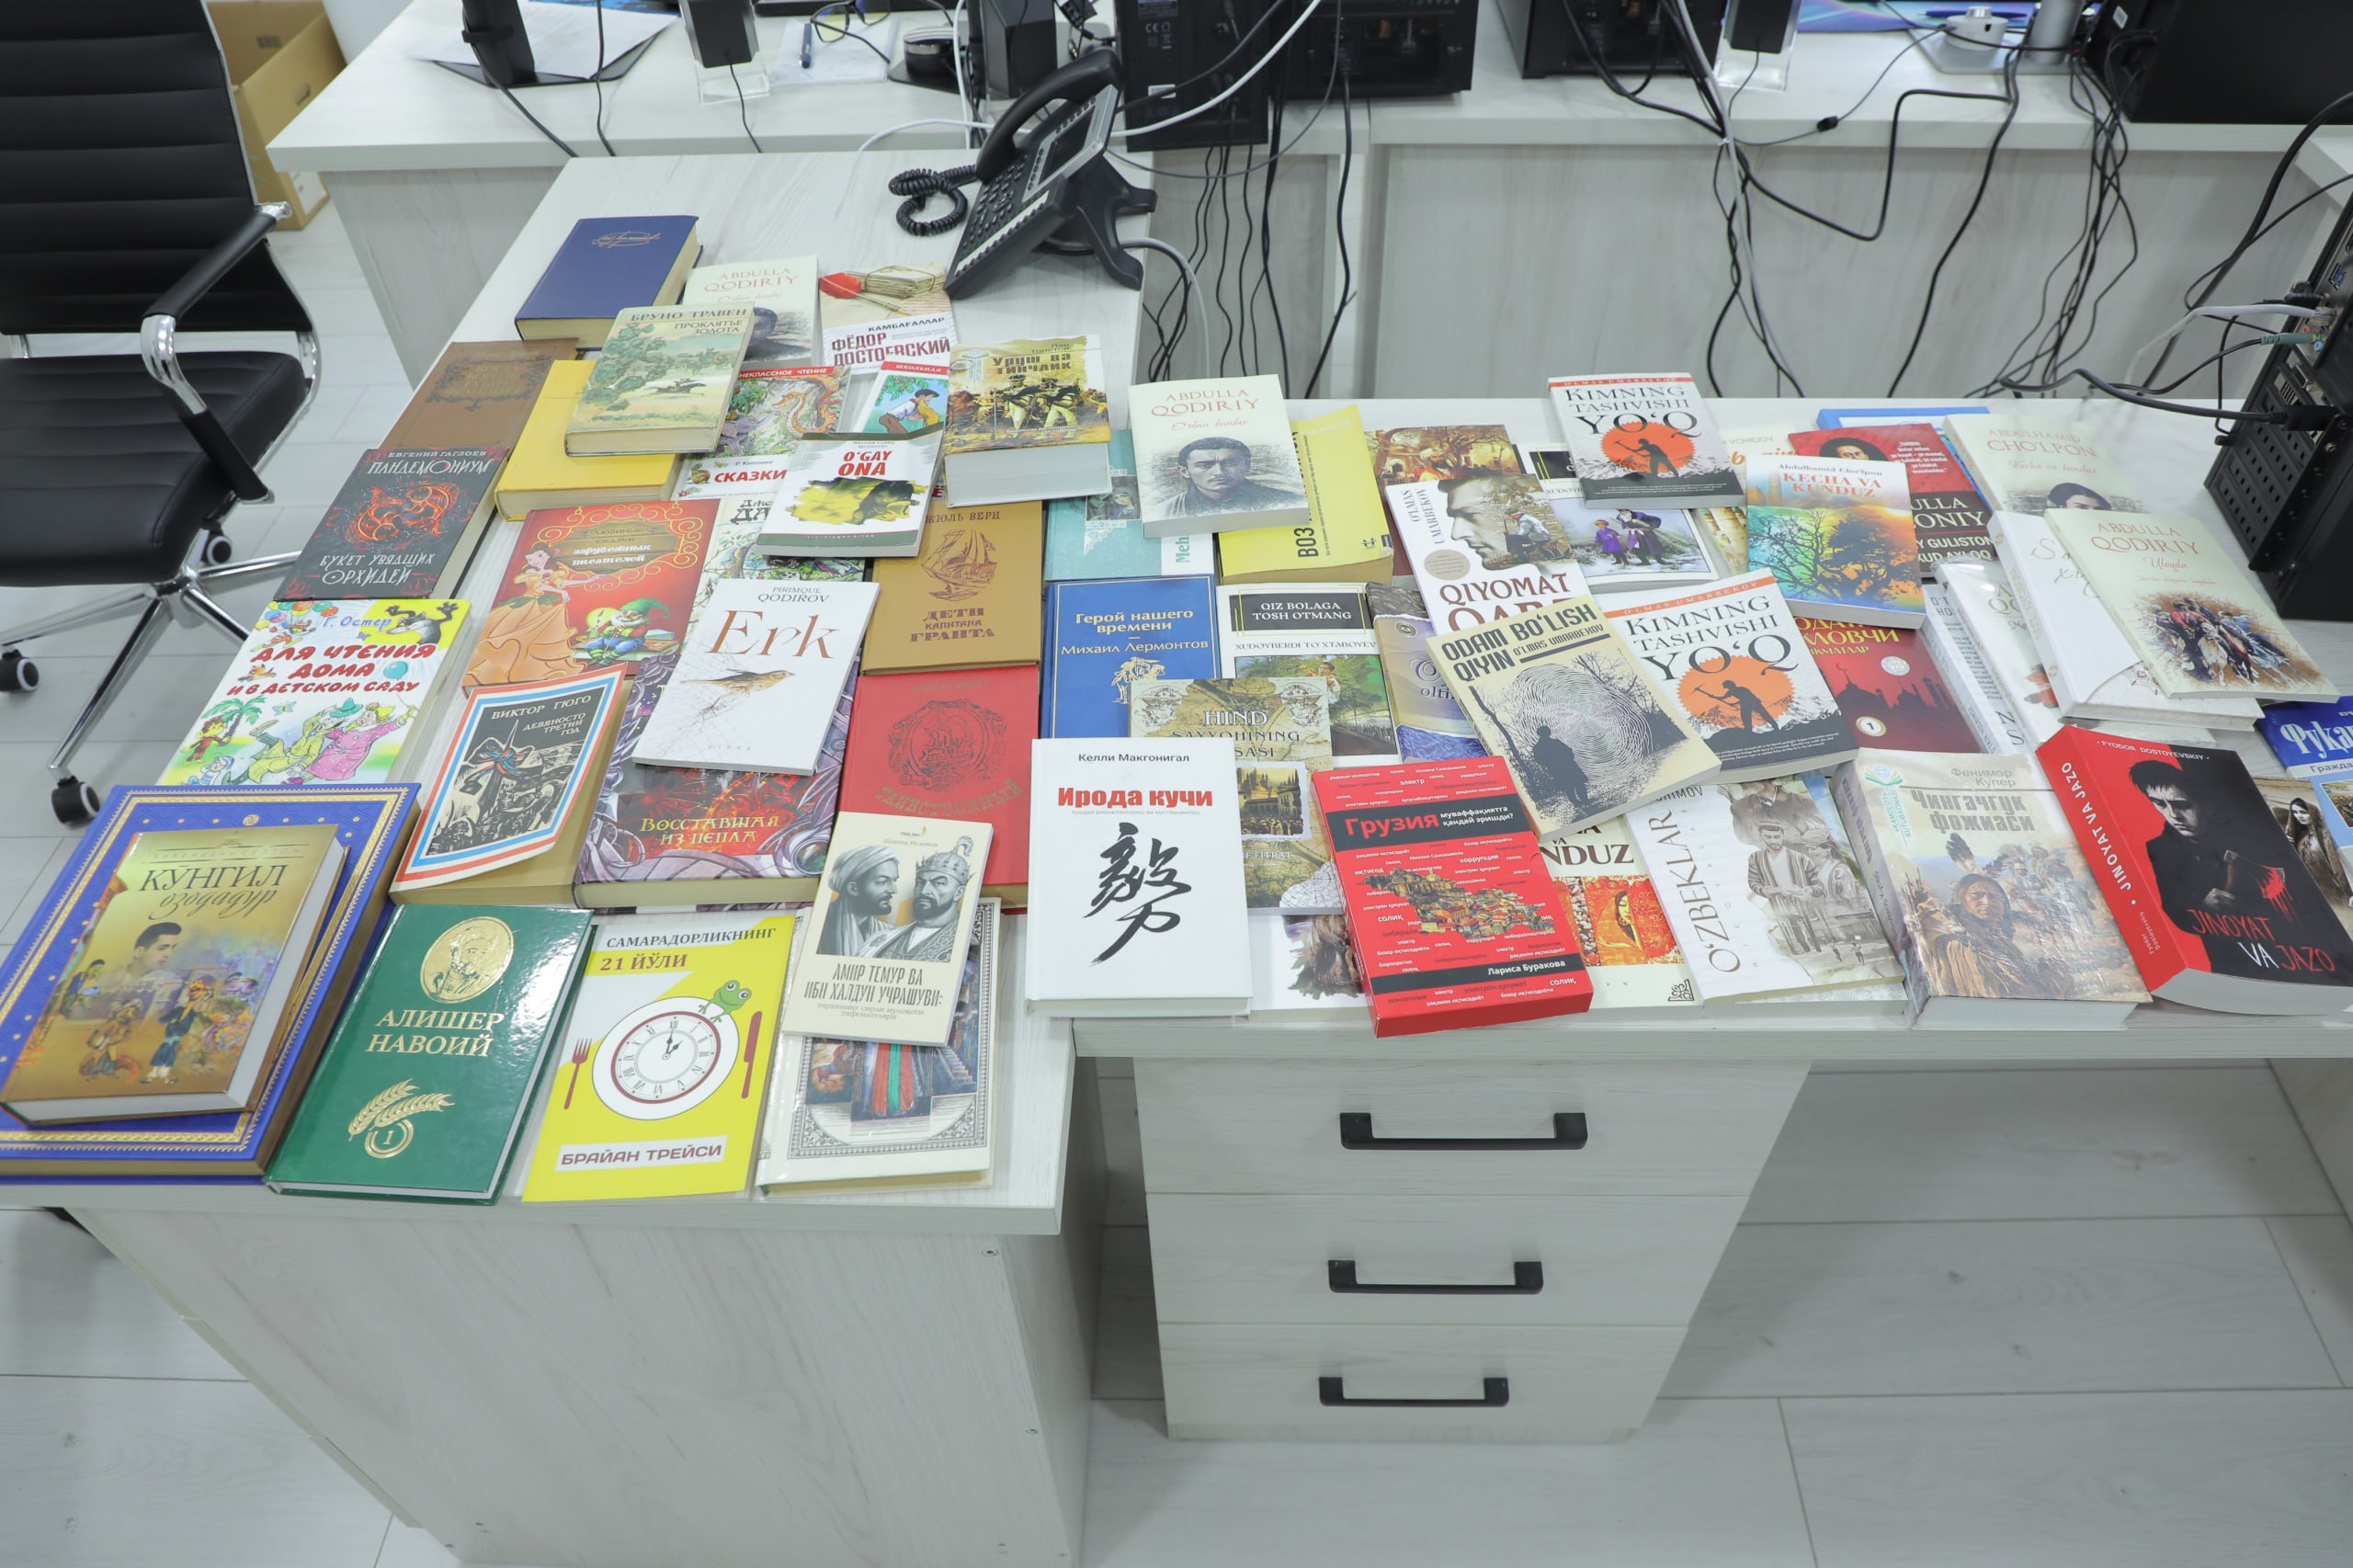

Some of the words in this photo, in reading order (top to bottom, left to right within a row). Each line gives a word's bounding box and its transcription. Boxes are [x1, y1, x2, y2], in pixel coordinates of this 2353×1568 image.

[719, 268, 790, 280] ABDULLA
[705, 276, 798, 291] QODIRIY
[631, 312, 683, 322] БРУНО
[690, 309, 747, 317] ТРАВЕН
[675, 320, 743, 330] ПРОКЛЯТЬЕ
[832, 333, 887, 352] ФЁДОР
[834, 337, 951, 367] ДОСТОЕВСКИЙ
[738, 369, 792, 379] НЕКЛАССНОЕ
[797, 368, 827, 376] ЧТЕНИЕ
[1165, 389, 1249, 402] ABDULLA
[1565, 386, 1685, 401] KIMNING
[1152, 398, 1259, 416] QODIRIY
[1569, 399, 1690, 413] TASHVISHI
[368, 459, 494, 475] ПАНДЕМОНИУМ
[838, 462, 886, 476] ONA
[714, 470, 788, 483] СКАЗКИ
[1783, 472, 1855, 485] KECHA
[1859, 478, 1883, 489] VA
[1792, 483, 1877, 498] KUNDUZ
[1912, 497, 1968, 510] ULLA
[926, 513, 963, 523] ЖЮЛЬ
[970, 511, 1000, 521] ВЕРН
[1915, 511, 1985, 528] ONIY
[2097, 522, 2182, 537] ABDULLA
[573, 544, 652, 555] зарубежных
[2091, 536, 2200, 554] QODIRIY
[320, 554, 365, 571] БУКЕТ
[572, 554, 646, 566] писателей
[322, 567, 413, 586] ОРХИДЕЙ
[1439, 573, 1572, 606] QIYOMAT
[1676, 582, 1758, 607] UMARBEKOV
[757, 594, 830, 603] QODIROV
[1260, 602, 1284, 611] QIZ
[1287, 601, 1341, 610] BOLAGA
[923, 608, 985, 621] ДЕТИ
[1075, 611, 1125, 626] Герой
[1131, 610, 1194, 621] нашего
[1253, 612, 1289, 620] TOSH
[1292, 610, 1352, 619] OTMANG
[1625, 596, 1770, 636] KIMNING
[324, 616, 334, 628] Г.
[341, 615, 392, 632] Остер
[925, 619, 982, 631] КАПИТАНА
[1097, 621, 1172, 635] времени
[705, 609, 840, 659] Erk
[909, 629, 996, 642] ГРАНТА
[1548, 623, 1604, 645] UMARBEKOV
[1633, 614, 1780, 652] TASHVISHI
[1061, 645, 1120, 655] Михаил
[1124, 641, 1210, 653] Лермонтов
[1235, 642, 1302, 651] XUDOYBERDI
[1441, 628, 1509, 662] ODAM
[249, 646, 315, 663] ДЛЯ
[324, 644, 437, 659] ЧТЕНИЯ
[288, 662, 375, 679] ДОМА
[1453, 653, 1515, 682] QIYIN
[226, 685, 240, 696] И
[245, 685, 256, 695] В
[260, 682, 359, 695] ДЕТСКОМ
[363, 681, 420, 693] САДУ
[491, 705, 545, 720] ВИКТОР
[553, 695, 592, 710] ГЮГО
[523, 712, 586, 732] ДЕВЯНОСТО
[543, 719, 584, 733] ТРЕТИЙ
[1204, 710, 1269, 727] HIND
[561, 727, 580, 736] ГОД
[1078, 753, 1116, 762] Келли
[1119, 753, 1190, 763] Макгонигал
[1235, 747, 1275, 757] SASI
[2101, 740, 2137, 751] FYODOR
[2140, 747, 2204, 760] DOSTOYEVSKIY
[1950, 767, 2013, 778] Фенимор
[2310, 762, 2353, 774] Гражда
[1400, 778, 1425, 786] электр
[1975, 778, 2016, 788] Купер
[2062, 761, 2087, 799] JAZO
[1058, 788, 1142, 808] Ирода
[1149, 790, 1213, 808] кучи
[1911, 790, 2027, 815] Чингачгук
[1440, 806, 1508, 818] муваффақиятга
[1443, 816, 1474, 826] қандай
[1476, 812, 1514, 824] эришди?
[2082, 803, 2097, 822] VA
[1345, 812, 1440, 839] Грузия
[1929, 811, 2036, 834] фожиаси
[660, 833, 684, 846] ИЗ
[691, 831, 757, 845] ПЕПЛА
[1255, 851, 1292, 859] FITRAT
[1460, 854, 1499, 864] коррупция
[1540, 844, 1634, 866] NDUZ
[2092, 826, 2132, 891] JINOYAT
[139, 865, 290, 892] КЎНГИЛ
[1354, 868, 1384, 876] иқтисод
[148, 890, 278, 920] озодадур
[2187, 909, 2275, 941] JINOYAT
[607, 927, 777, 949] САМАРАДОРЛИКНИНГ
[599, 957, 623, 971] 21
[631, 952, 688, 971] ЙЎЛИ
[2238, 941, 2279, 968] VA
[2275, 945, 2336, 971] JAZO
[832, 963, 865, 982] АМИР
[869, 965, 906, 985] ТЕМУР
[908, 969, 923, 986] ВА
[1487, 965, 1521, 976] Лариса
[1523, 960, 1566, 971] Буракова
[1550, 978, 1576, 986] солиқ
[803, 981, 828, 999] ИБН
[829, 983, 874, 1003] ХАЛДУН
[878, 986, 944, 1007] УЧРАШУВИ:
[375, 1009, 506, 1031] АЛИШЕР
[365, 1033, 494, 1057] НАВОИЙ
[382, 1131, 394, 1144] 1
[561, 1148, 640, 1165] БРАЙАН
[646, 1144, 722, 1161] ТРЕЙСИ
